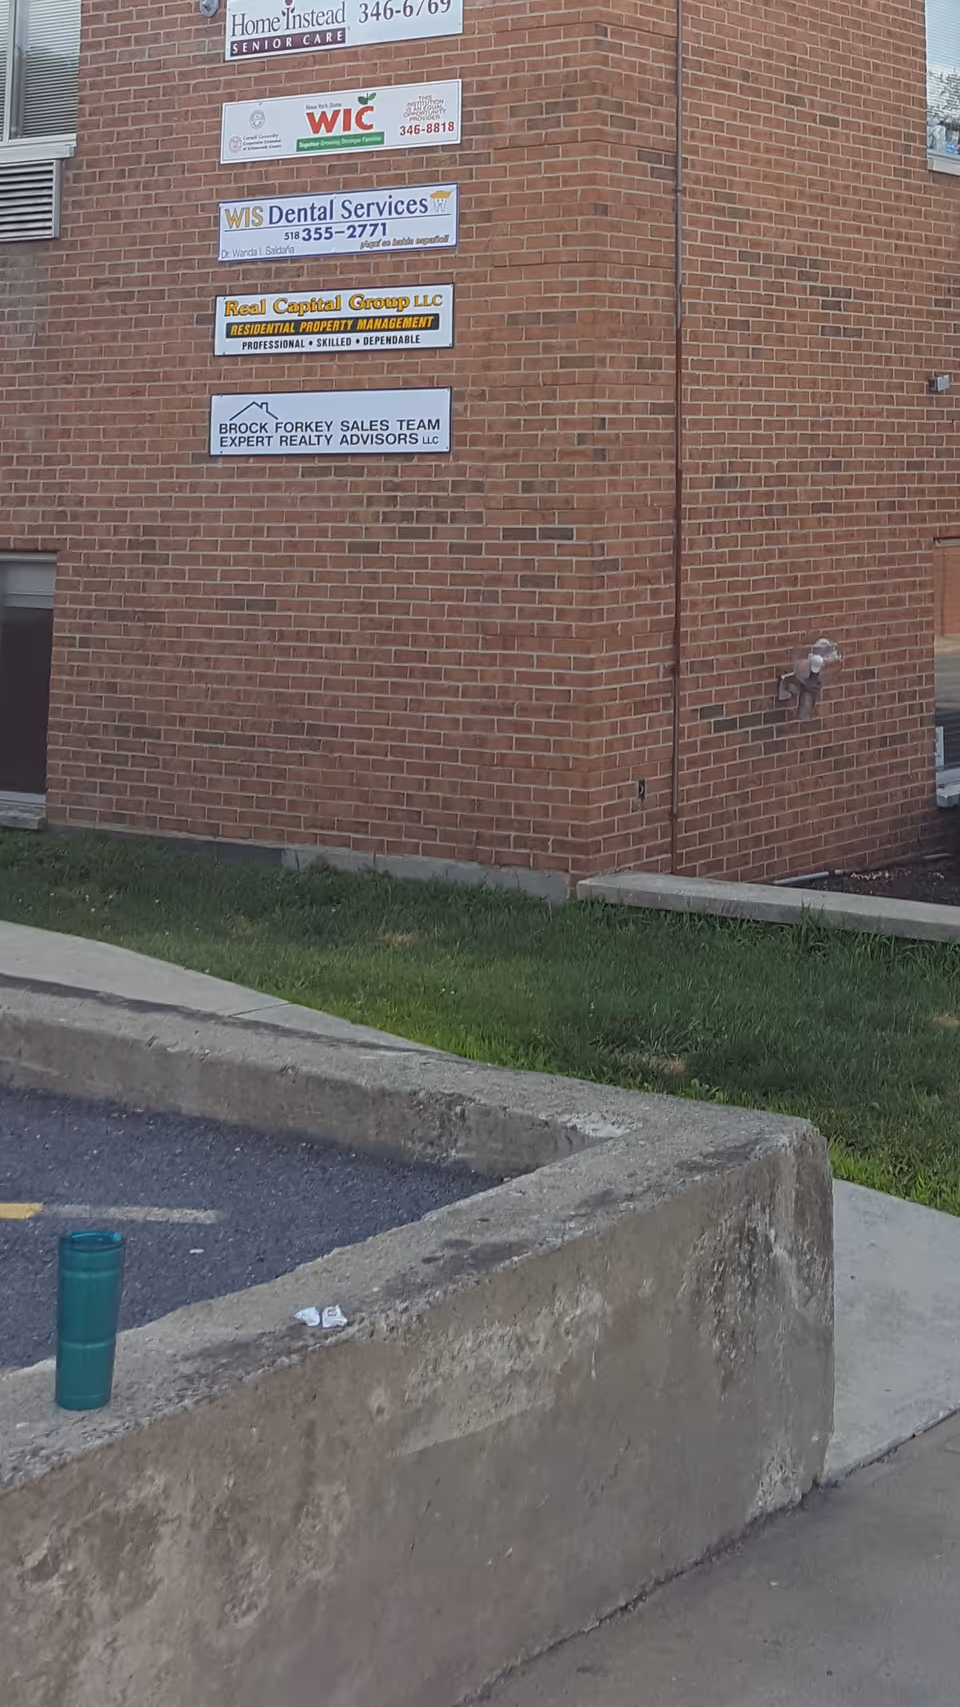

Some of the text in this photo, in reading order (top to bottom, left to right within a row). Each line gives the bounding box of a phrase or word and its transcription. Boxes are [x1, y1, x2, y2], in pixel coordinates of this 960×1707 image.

[230, 12, 281, 38] Home
[283, 0, 346, 31] Instead
[232, 30, 343, 54] SENIOR CARE
[305, 105, 375, 135] WIC
[399, 121, 455, 136] 346-8818
[224, 194, 428, 229] WIS Dental Services
[283, 222, 387, 242] 518 355-2771
[232, 247, 258, 258] Wanda
[265, 245, 295, 256] Saldaña
[224, 293, 444, 317] Real Capital Group LLC
[230, 316, 435, 336] RESIDENTIAL PROPERTY MANAGEMENT
[241, 334, 421, 351] PROFESSIONAL SKILLED DEPENDABLE
[218, 418, 441, 434] BROCK FORKEY SALES TEAM
[219, 432, 439, 448] EXPERT REALTY ADVISORS LLC
